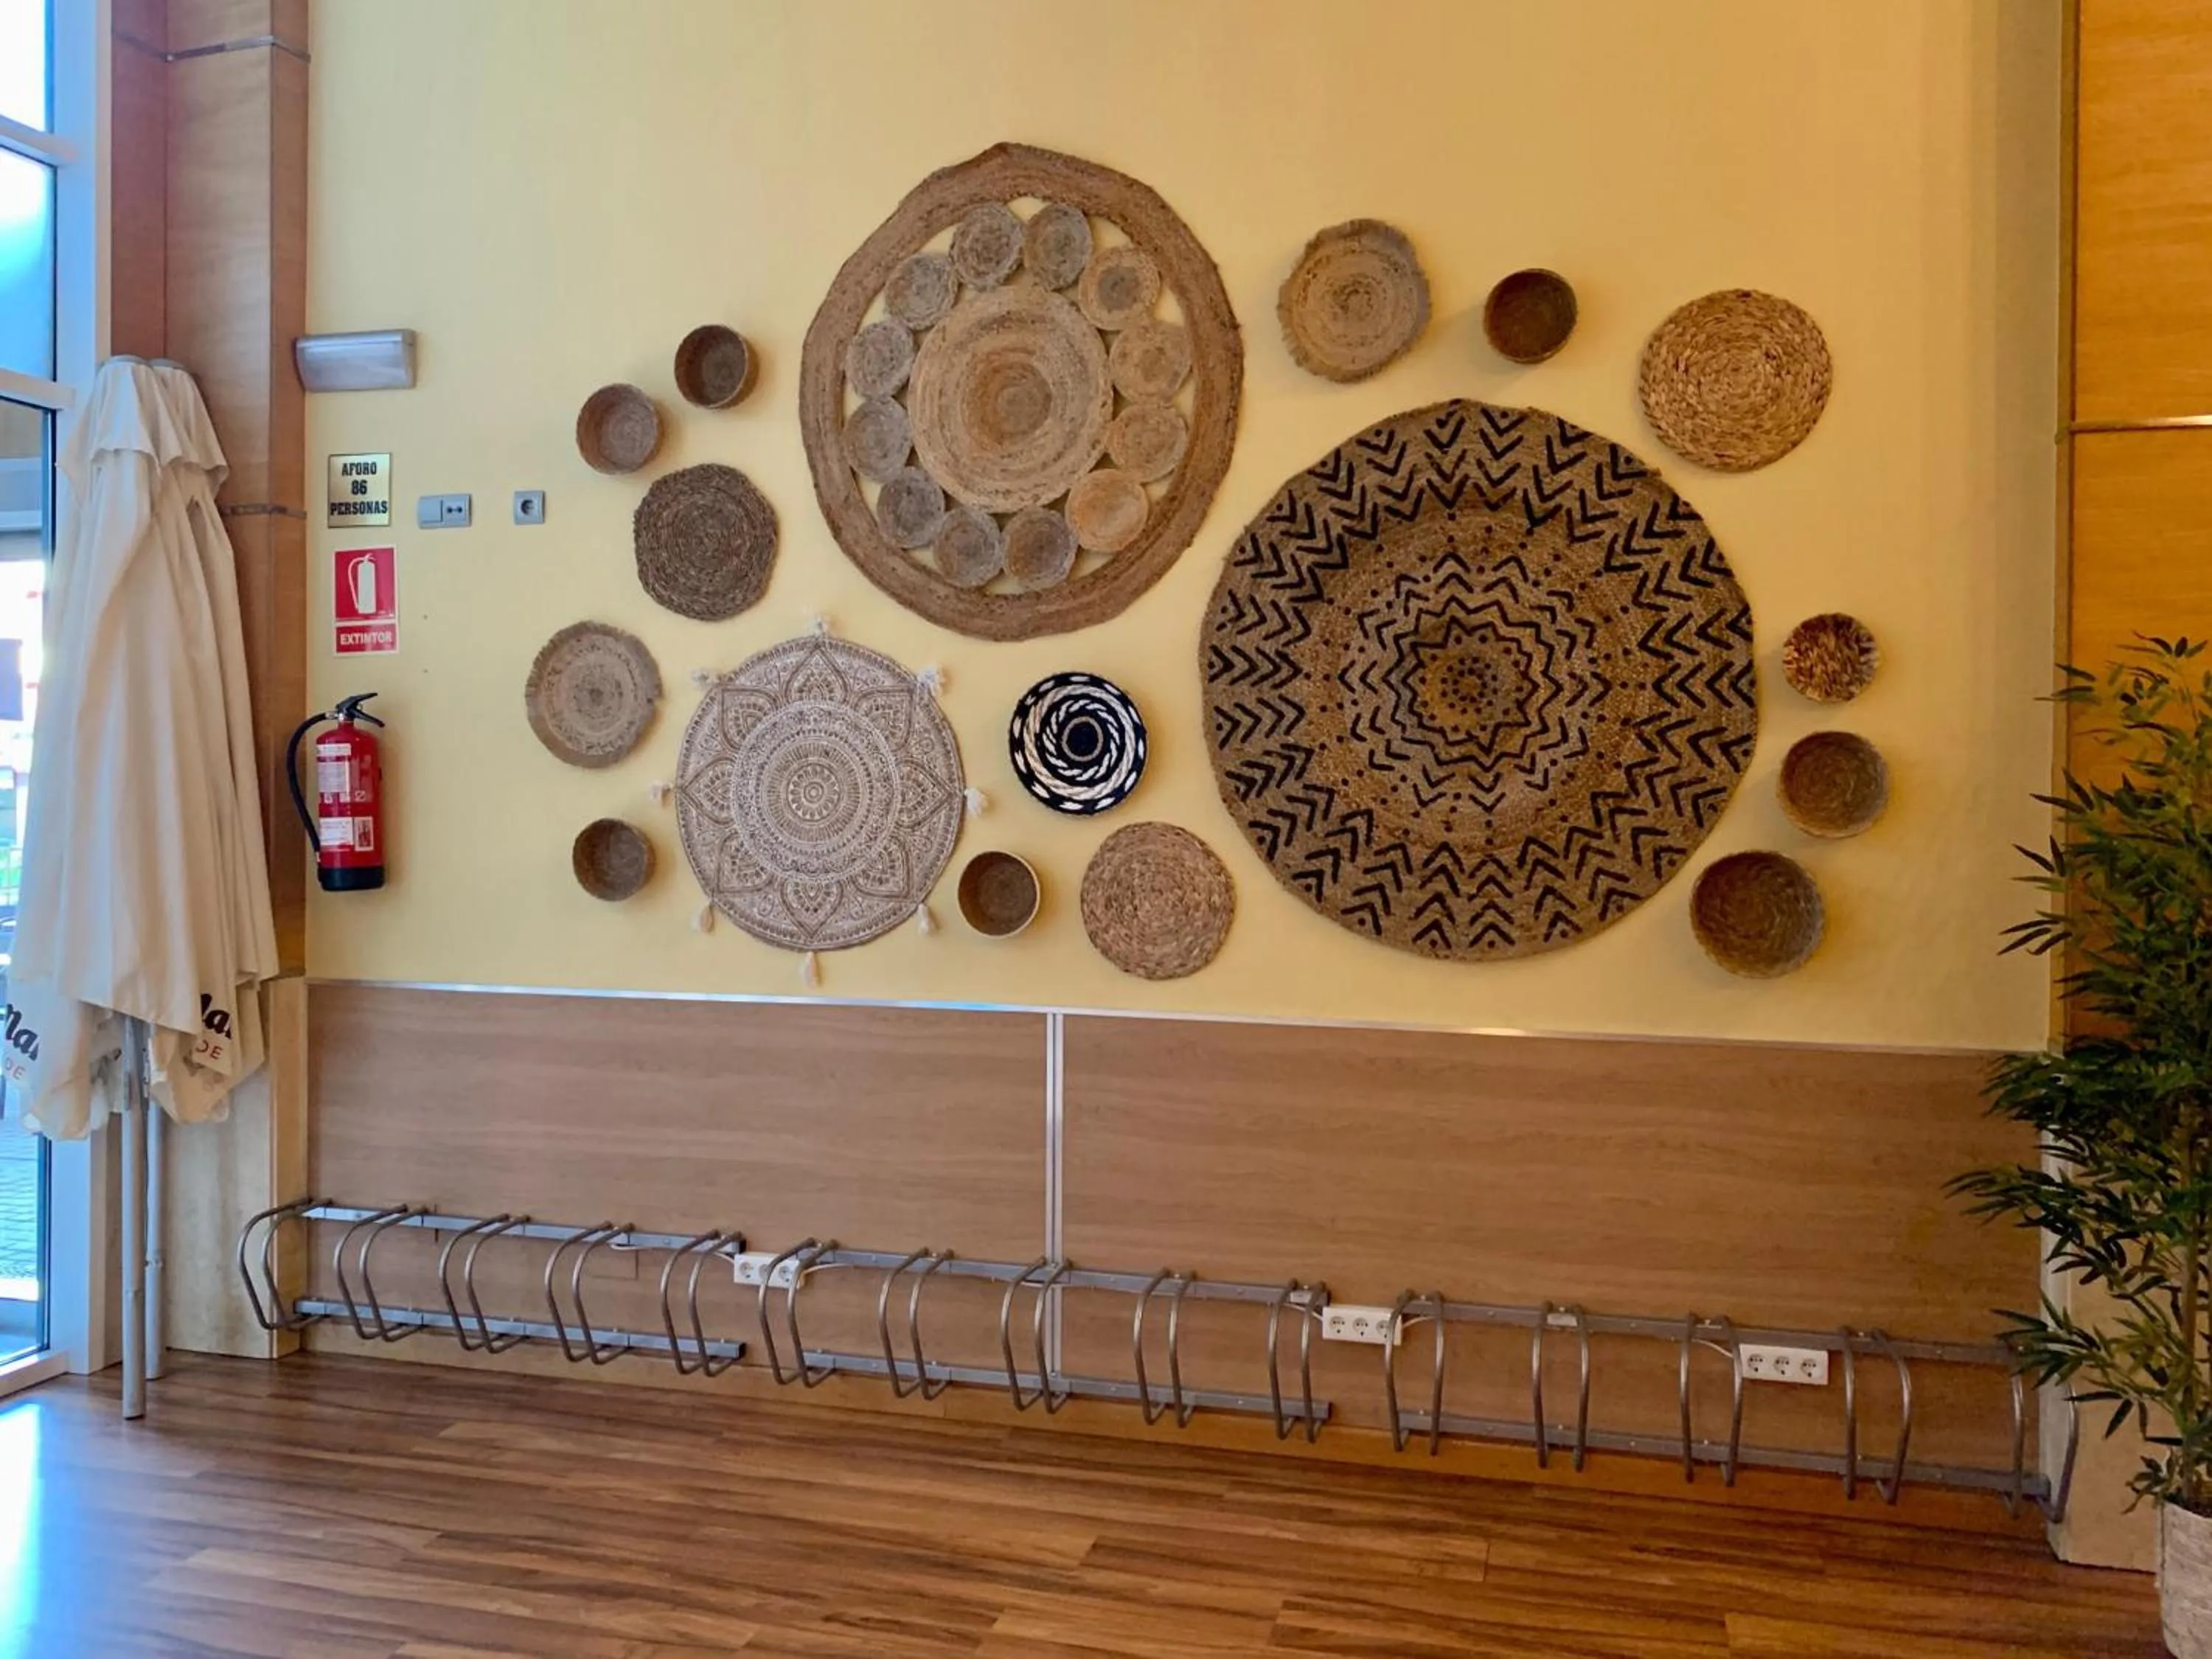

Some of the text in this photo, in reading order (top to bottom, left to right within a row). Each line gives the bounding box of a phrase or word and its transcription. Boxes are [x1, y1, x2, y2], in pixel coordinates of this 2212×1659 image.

[341, 462, 377, 476] AFORO
[352, 479, 367, 495] 86
[330, 500, 388, 515] PERSONAS
[340, 631, 392, 645] EXTINTOR
